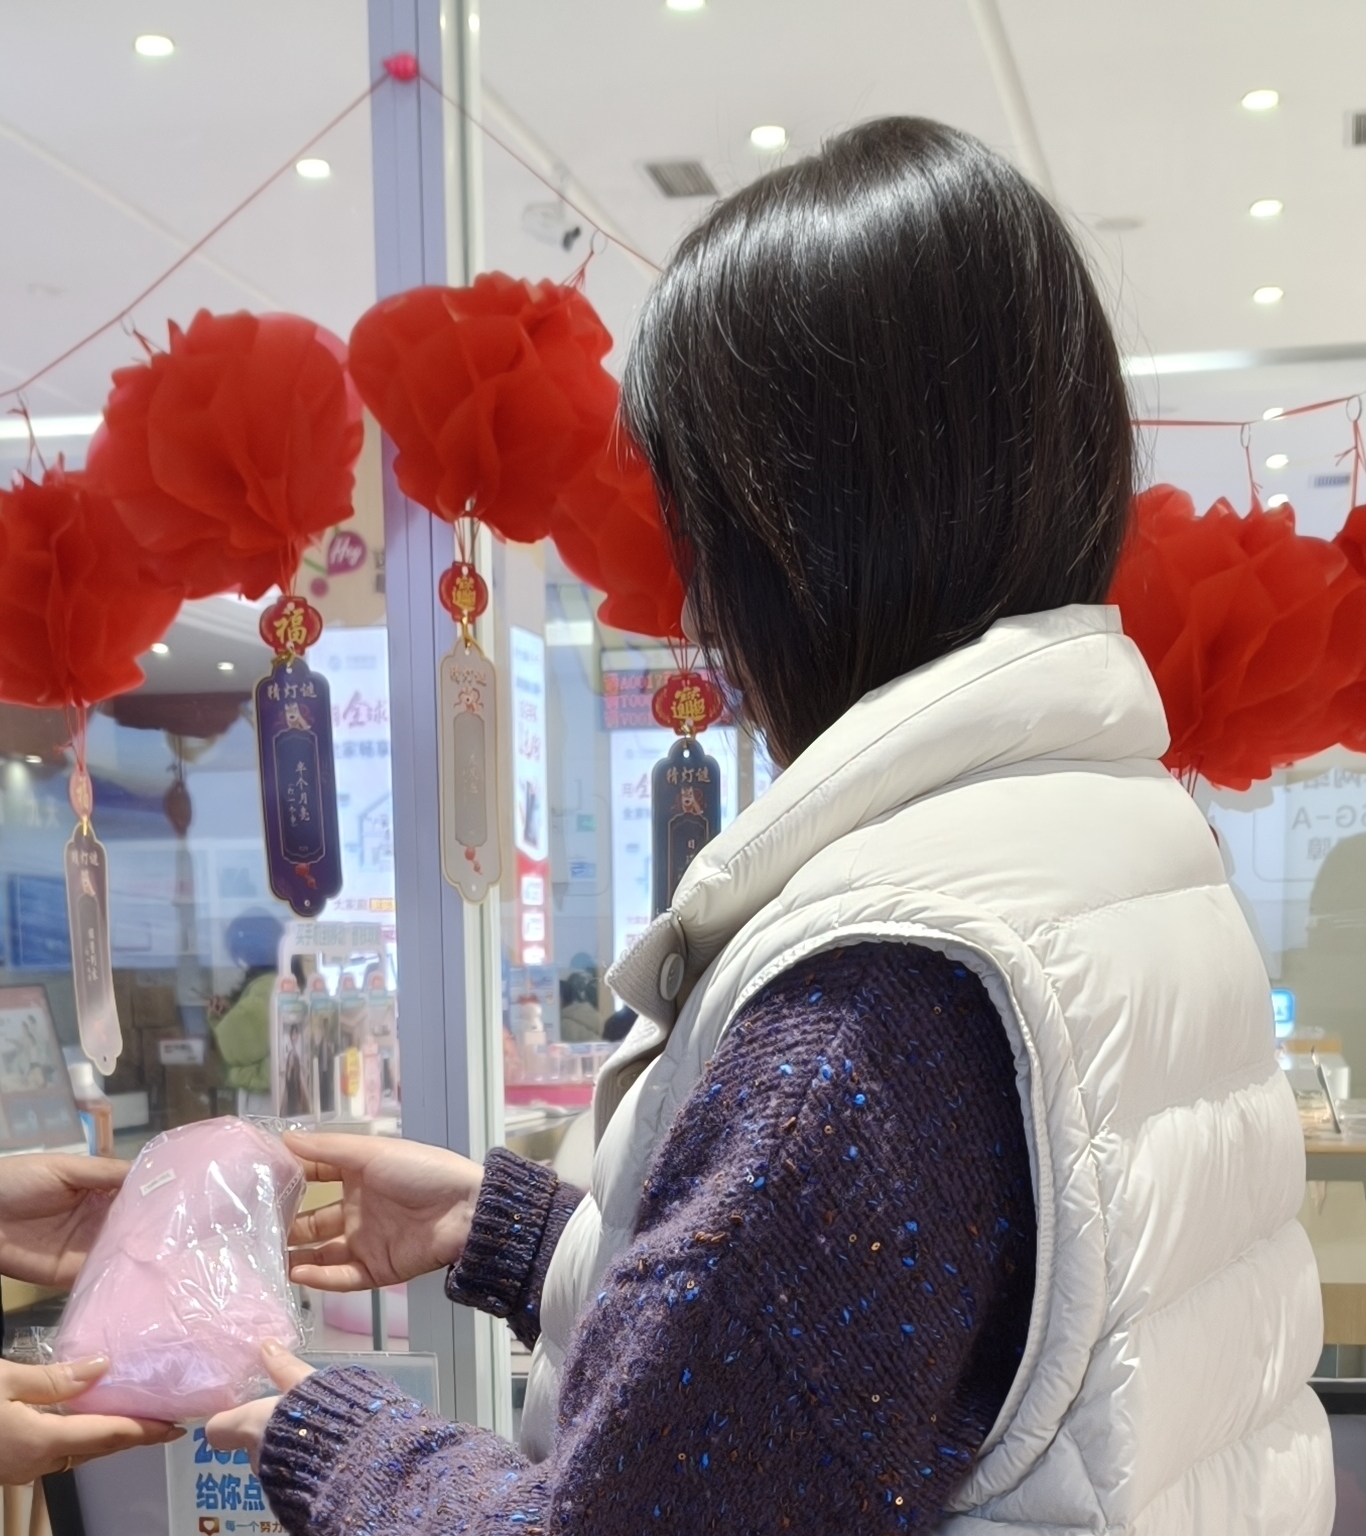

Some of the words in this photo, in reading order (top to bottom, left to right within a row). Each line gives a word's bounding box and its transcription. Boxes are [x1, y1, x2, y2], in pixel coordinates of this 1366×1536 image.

[274, 607, 307, 645] 福
[267, 682, 317, 700] 猜灯谜
[666, 767, 710, 785] 猜灯谜
